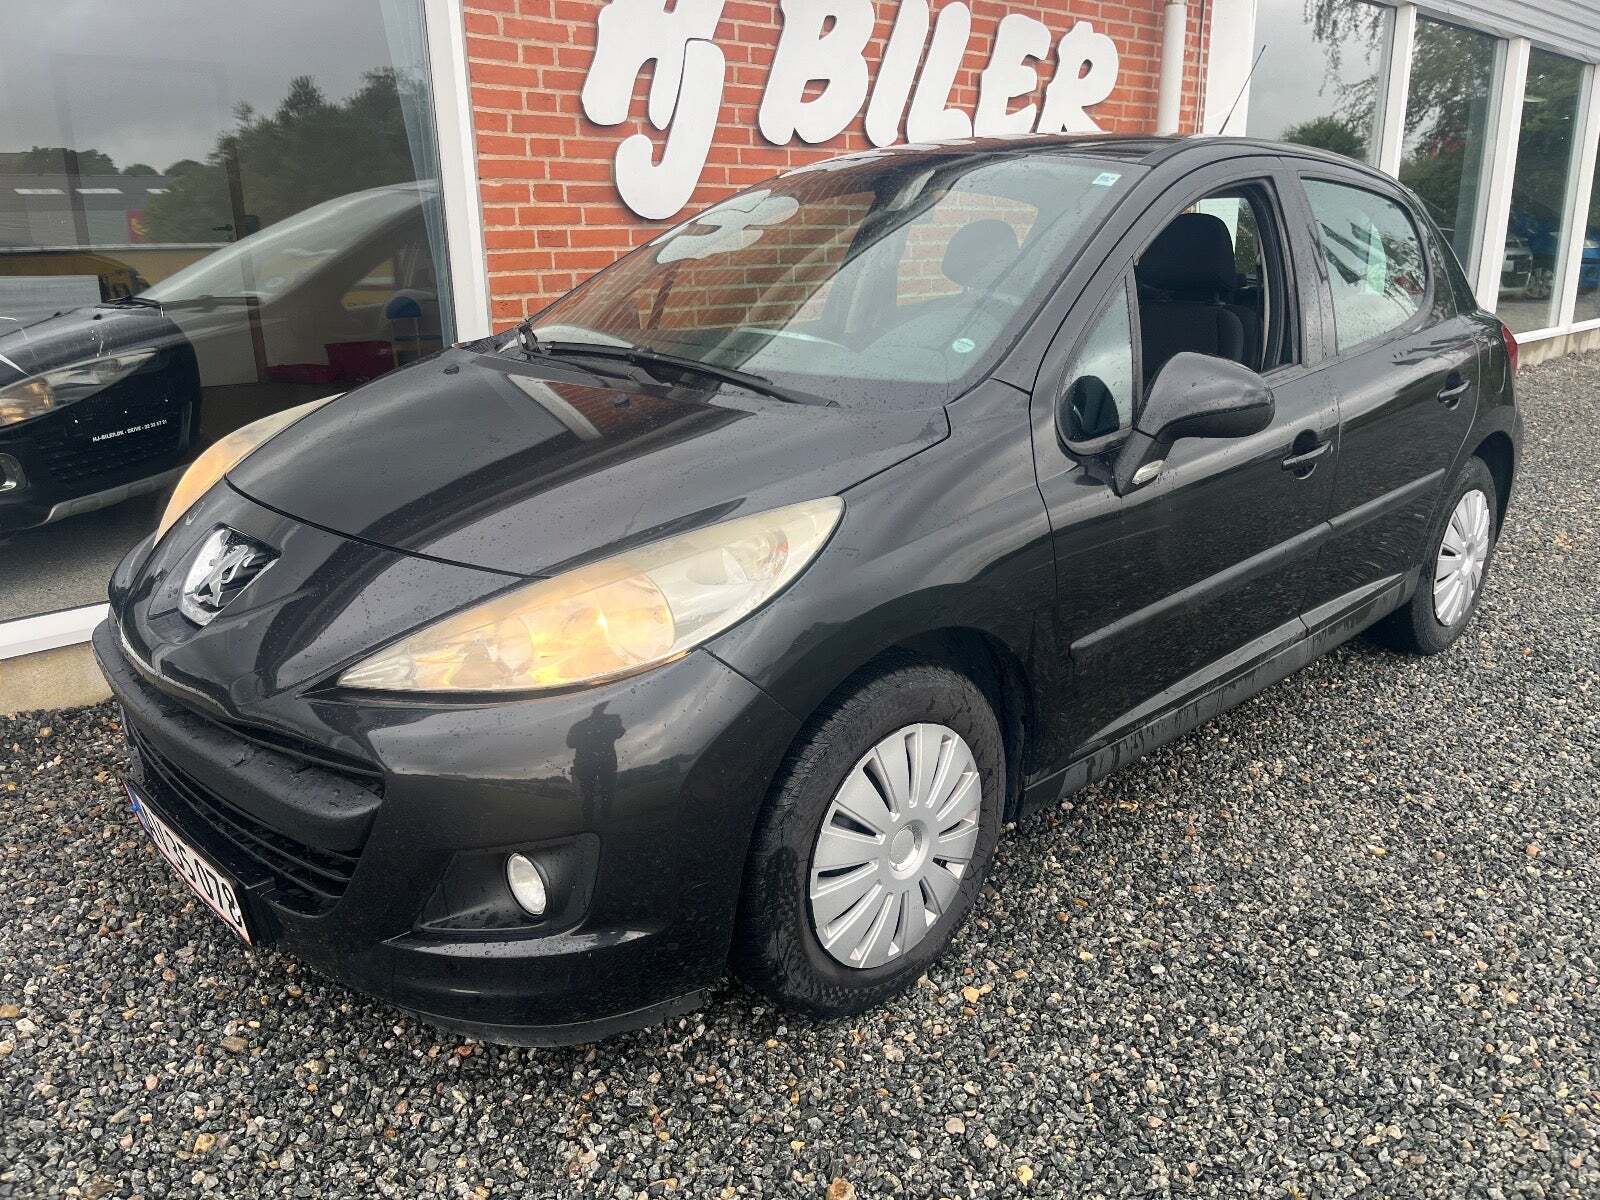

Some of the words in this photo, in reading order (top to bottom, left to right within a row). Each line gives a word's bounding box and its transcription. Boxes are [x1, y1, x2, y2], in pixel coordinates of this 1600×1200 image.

[582, 0, 726, 219] HJ
[758, 0, 1119, 147] BILER
[164, 829, 196, 882] 35
[194, 858, 243, 928] 078
